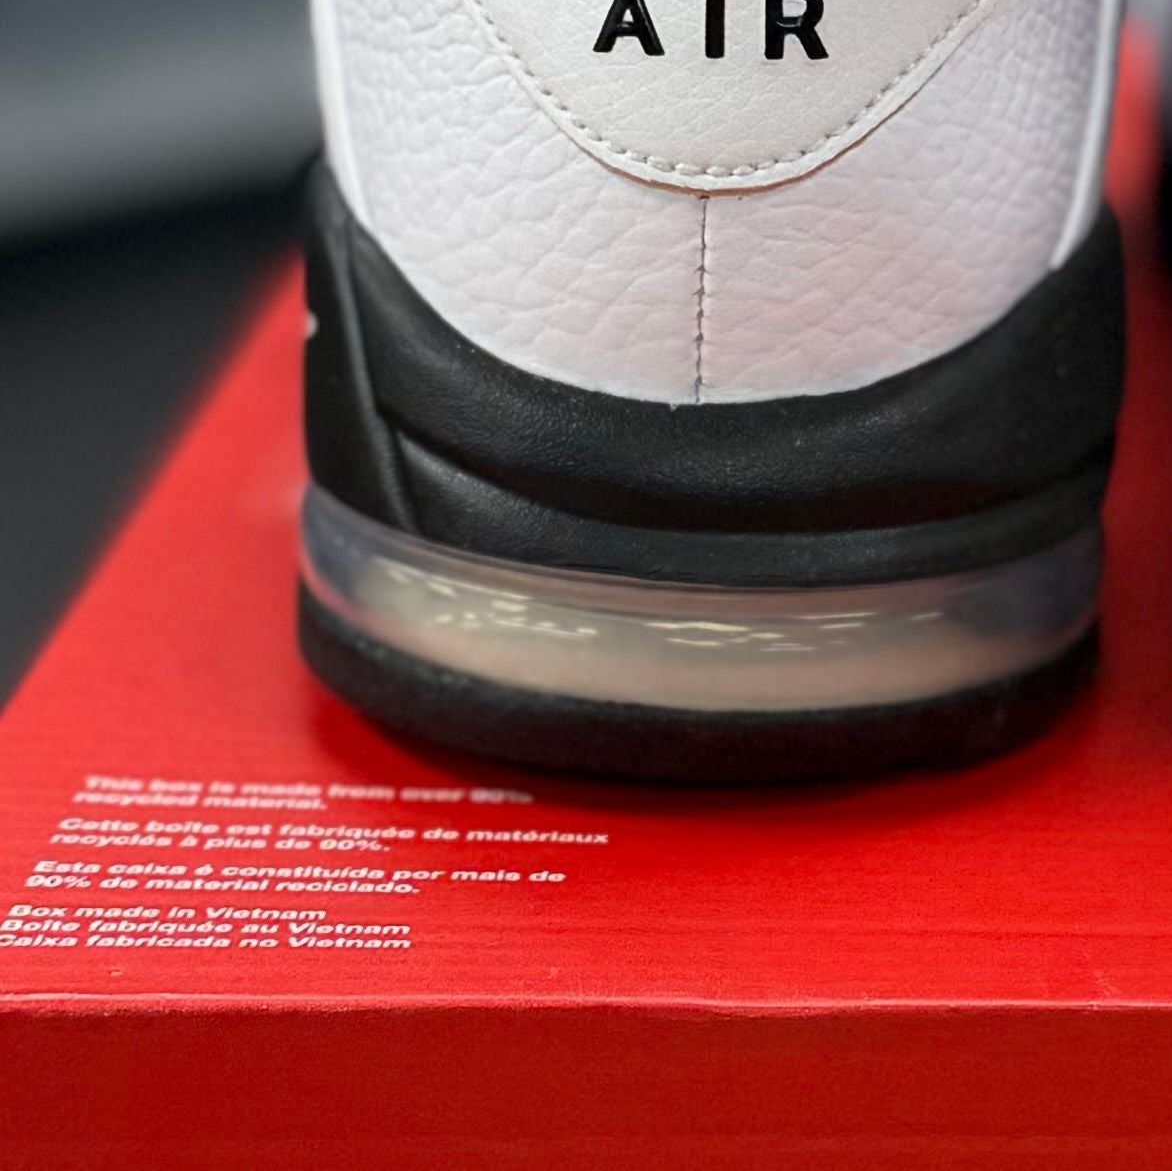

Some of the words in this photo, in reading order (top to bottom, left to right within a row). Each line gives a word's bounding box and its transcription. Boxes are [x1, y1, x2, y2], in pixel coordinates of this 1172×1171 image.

[85, 776, 144, 791] This
[241, 782, 321, 796] made
[328, 784, 395, 799] from
[73, 791, 199, 807] recycled
[203, 795, 327, 810] material.
[58, 817, 139, 831] Cette
[227, 824, 272, 836] est
[279, 823, 415, 840] fabriquée
[422, 828, 459, 841] de
[466, 829, 609, 843] matériaux
[49, 832, 173, 848] recyclés
[203, 836, 267, 850] plus
[274, 838, 312, 850] de
[319, 838, 390, 852] 90%.
[33, 860, 101, 875] Esta
[107, 862, 187, 875] caixa
[221, 866, 385, 879] constituída
[392, 870, 446, 882] por
[451, 869, 521, 882] mais
[529, 870, 566, 883] de
[25, 874, 91, 888] 90%
[99, 876, 138, 889] de
[145, 878, 269, 891] material
[275, 879, 420, 894] reciclado.
[8, 904, 68, 917] Box
[74, 905, 160, 918] made
[168, 906, 196, 918] in
[205, 907, 327, 920] Vietnam
[88, 920, 233, 935] fabriquée
[241, 924, 279, 934] au
[288, 922, 411, 935] Vietnam
[0, 934, 78, 947] Caixa
[84, 935, 231, 948] fabricada
[238, 937, 279, 948] no
[288, 936, 412, 949] Vietnam
